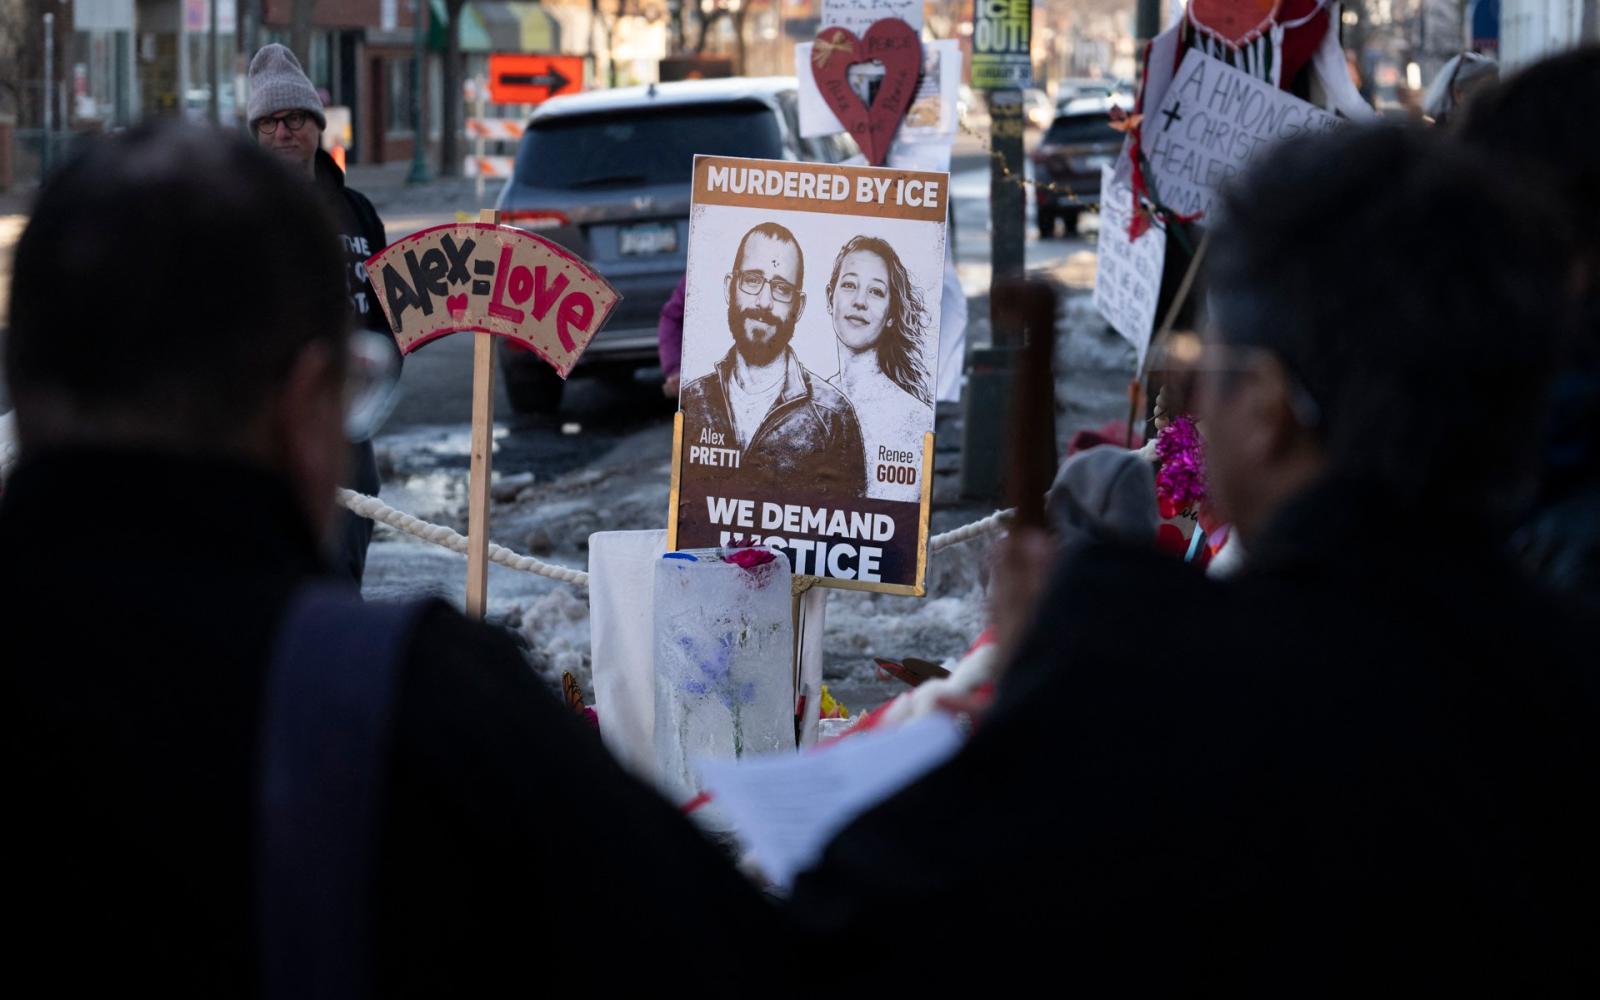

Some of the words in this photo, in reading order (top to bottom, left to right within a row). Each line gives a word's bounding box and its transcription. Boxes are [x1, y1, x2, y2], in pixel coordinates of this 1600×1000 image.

[976, 0, 1030, 18] ICE
[975, 19, 1030, 52] OUT!
[1179, 60, 1206, 102] A
[1207, 71, 1300, 140] HMONG
[707, 165, 850, 201] MURDERED
[855, 176, 892, 204] BY
[896, 179, 939, 208] ICE
[700, 428, 725, 446] Alex
[689, 445, 740, 468] PRETTI
[878, 445, 913, 464] Renee
[877, 464, 916, 485] GOOD
[706, 496, 754, 528] WE
[761, 502, 895, 541] DEMAND
[720, 531, 883, 583] TICE
